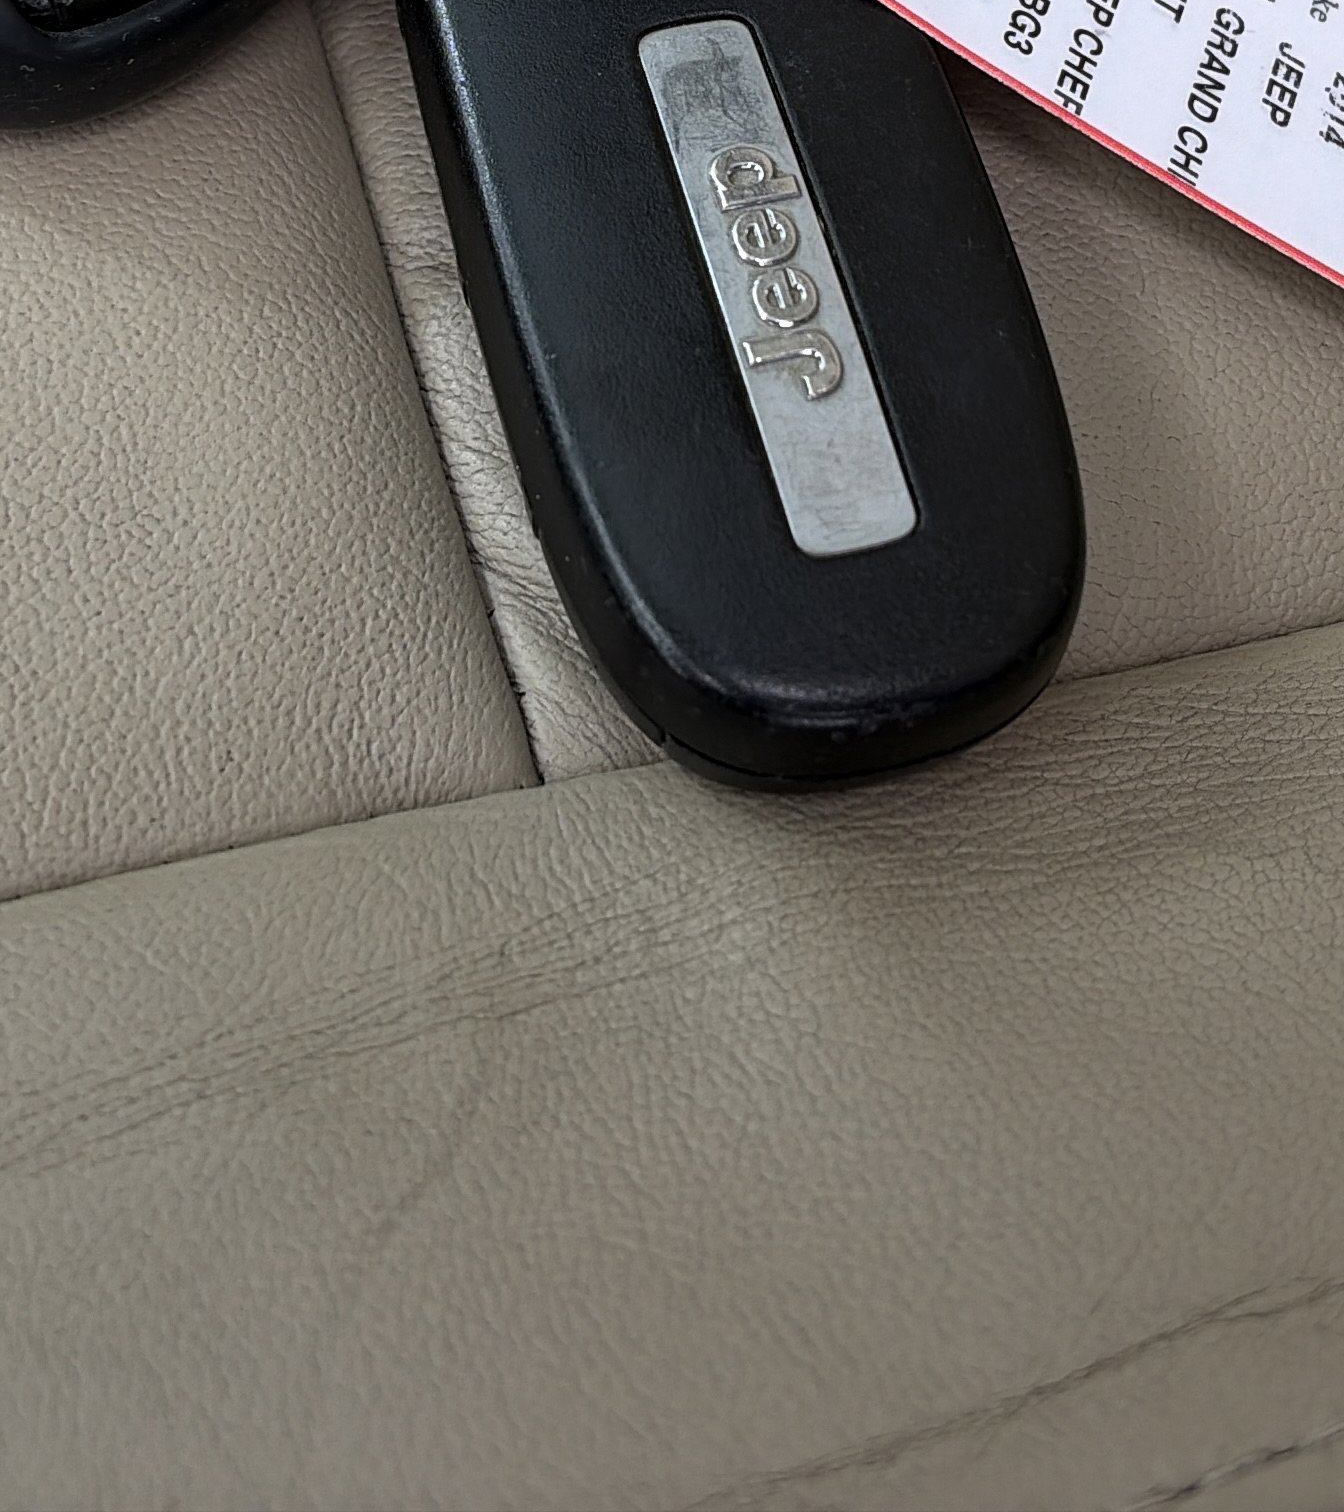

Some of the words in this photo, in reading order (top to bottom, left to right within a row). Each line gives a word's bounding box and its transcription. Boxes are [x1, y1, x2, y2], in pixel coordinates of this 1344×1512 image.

[1187, 7, 1246, 124] GRAND
[1262, 41, 1306, 128] JEEP
[1167, 125, 1208, 187] CH
[708, 145, 843, 399] Jeep
